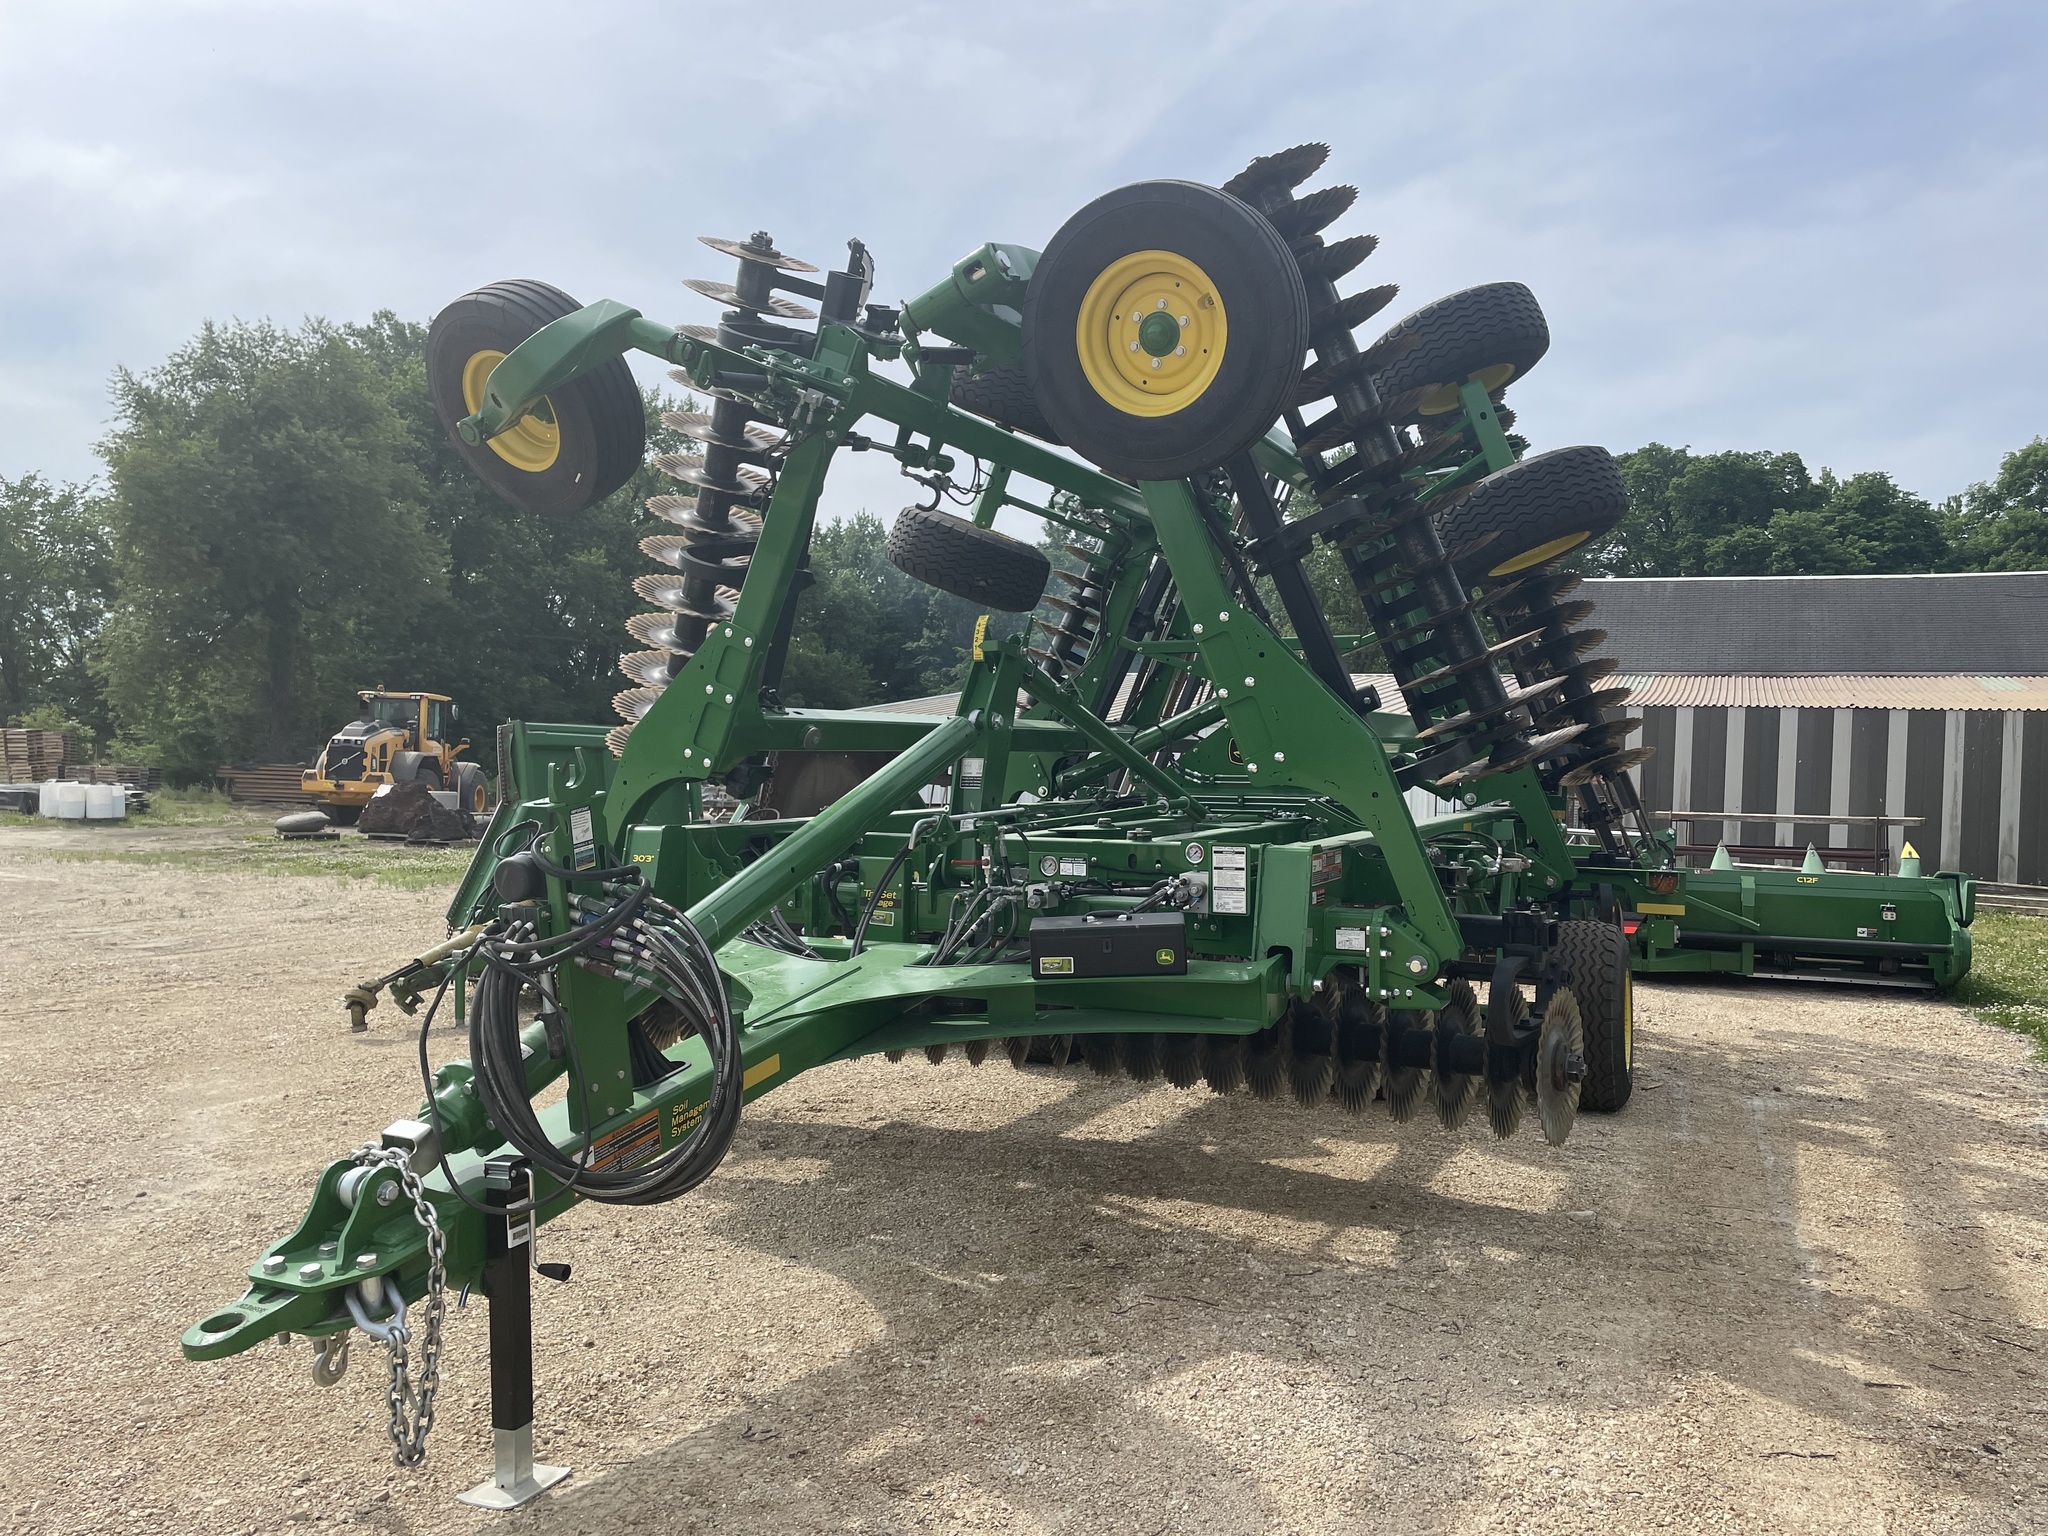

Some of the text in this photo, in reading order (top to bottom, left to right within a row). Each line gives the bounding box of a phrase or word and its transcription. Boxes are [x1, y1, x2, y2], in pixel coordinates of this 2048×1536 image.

[1796, 876, 1819, 884] C12F
[863, 889, 897, 900] TrSet
[671, 1100, 710, 1127] Managem
[672, 1099, 689, 1115] Soil
[671, 1114, 703, 1138] System
